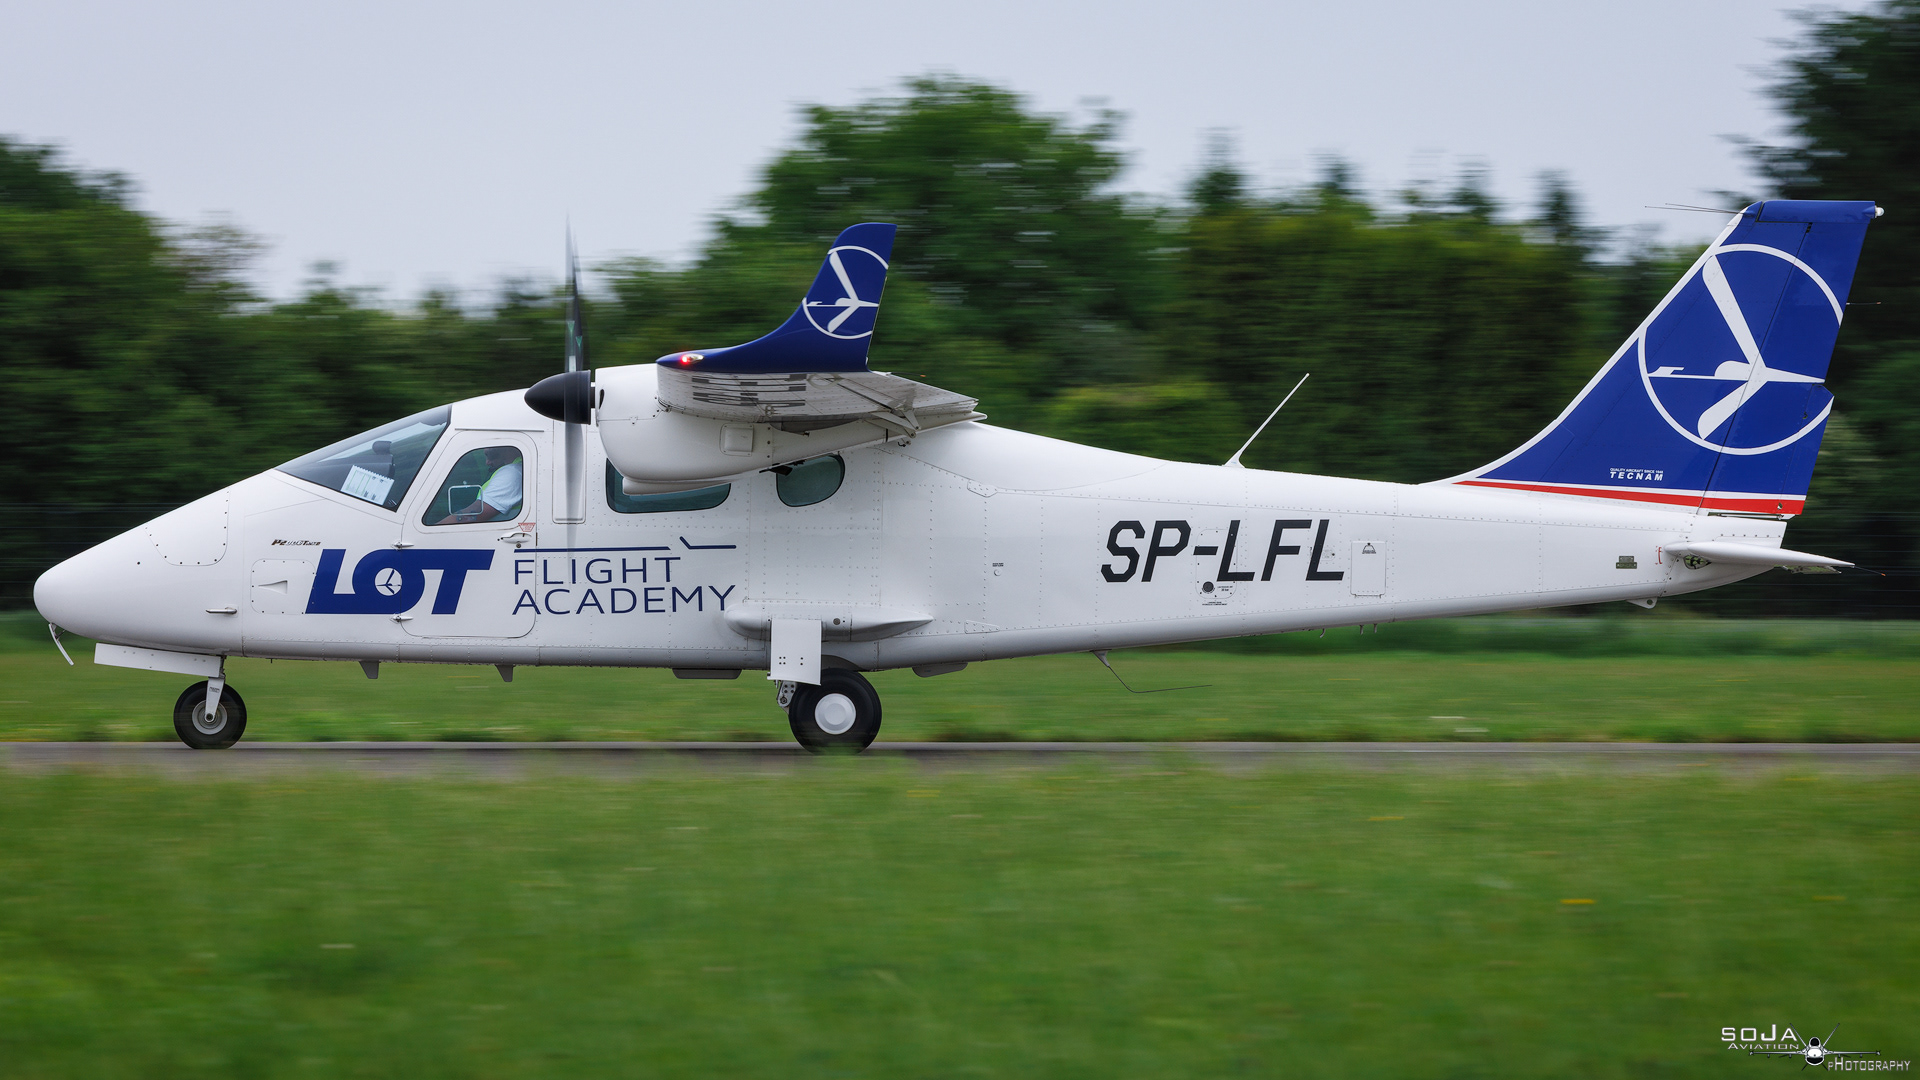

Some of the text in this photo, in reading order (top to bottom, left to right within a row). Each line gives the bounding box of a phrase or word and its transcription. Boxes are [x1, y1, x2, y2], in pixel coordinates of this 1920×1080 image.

[1610, 472, 1663, 481] TECNAM
[1101, 519, 1345, 583] SP-LFL
[305, 548, 495, 615] LOT
[514, 557, 681, 584] FLIGHT
[512, 585, 736, 615] ACADEMY
